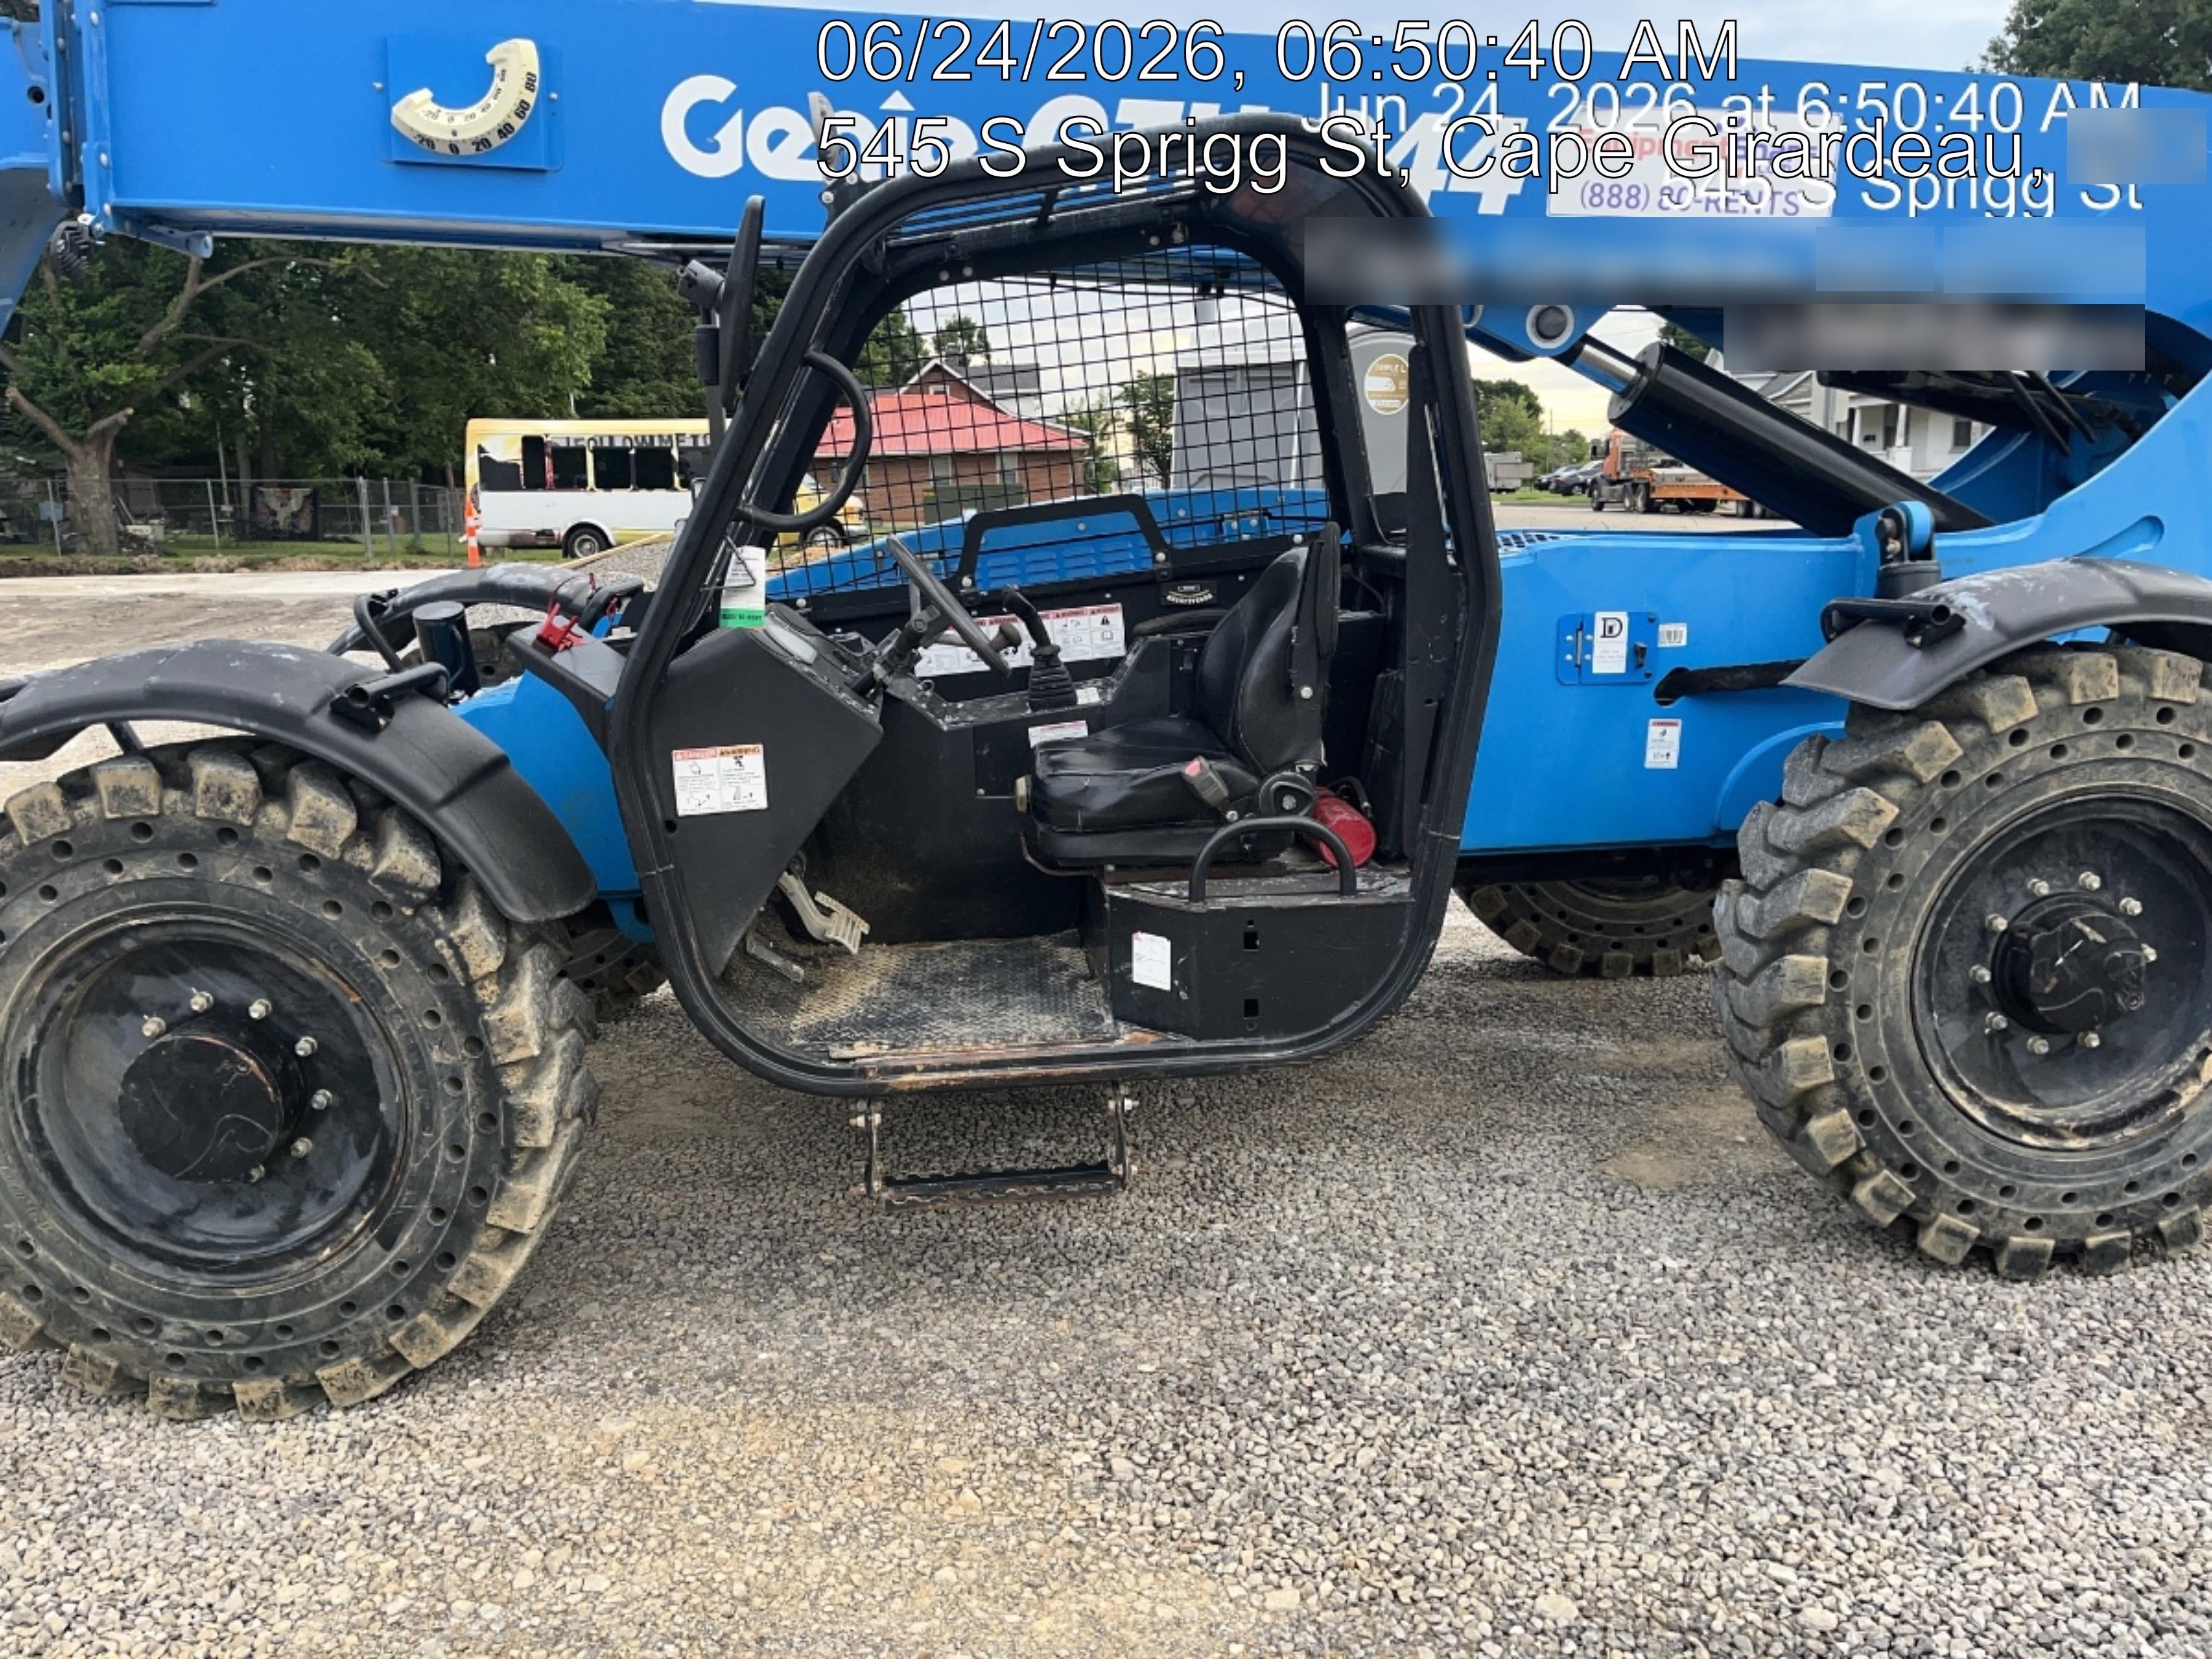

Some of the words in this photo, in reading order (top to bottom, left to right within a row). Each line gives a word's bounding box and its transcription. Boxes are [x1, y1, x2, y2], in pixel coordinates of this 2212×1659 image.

[471, 138, 492, 152] 20
[497, 122, 515, 139] 40
[514, 99, 530, 120] 60
[1580, 179, 1650, 211] (888)
